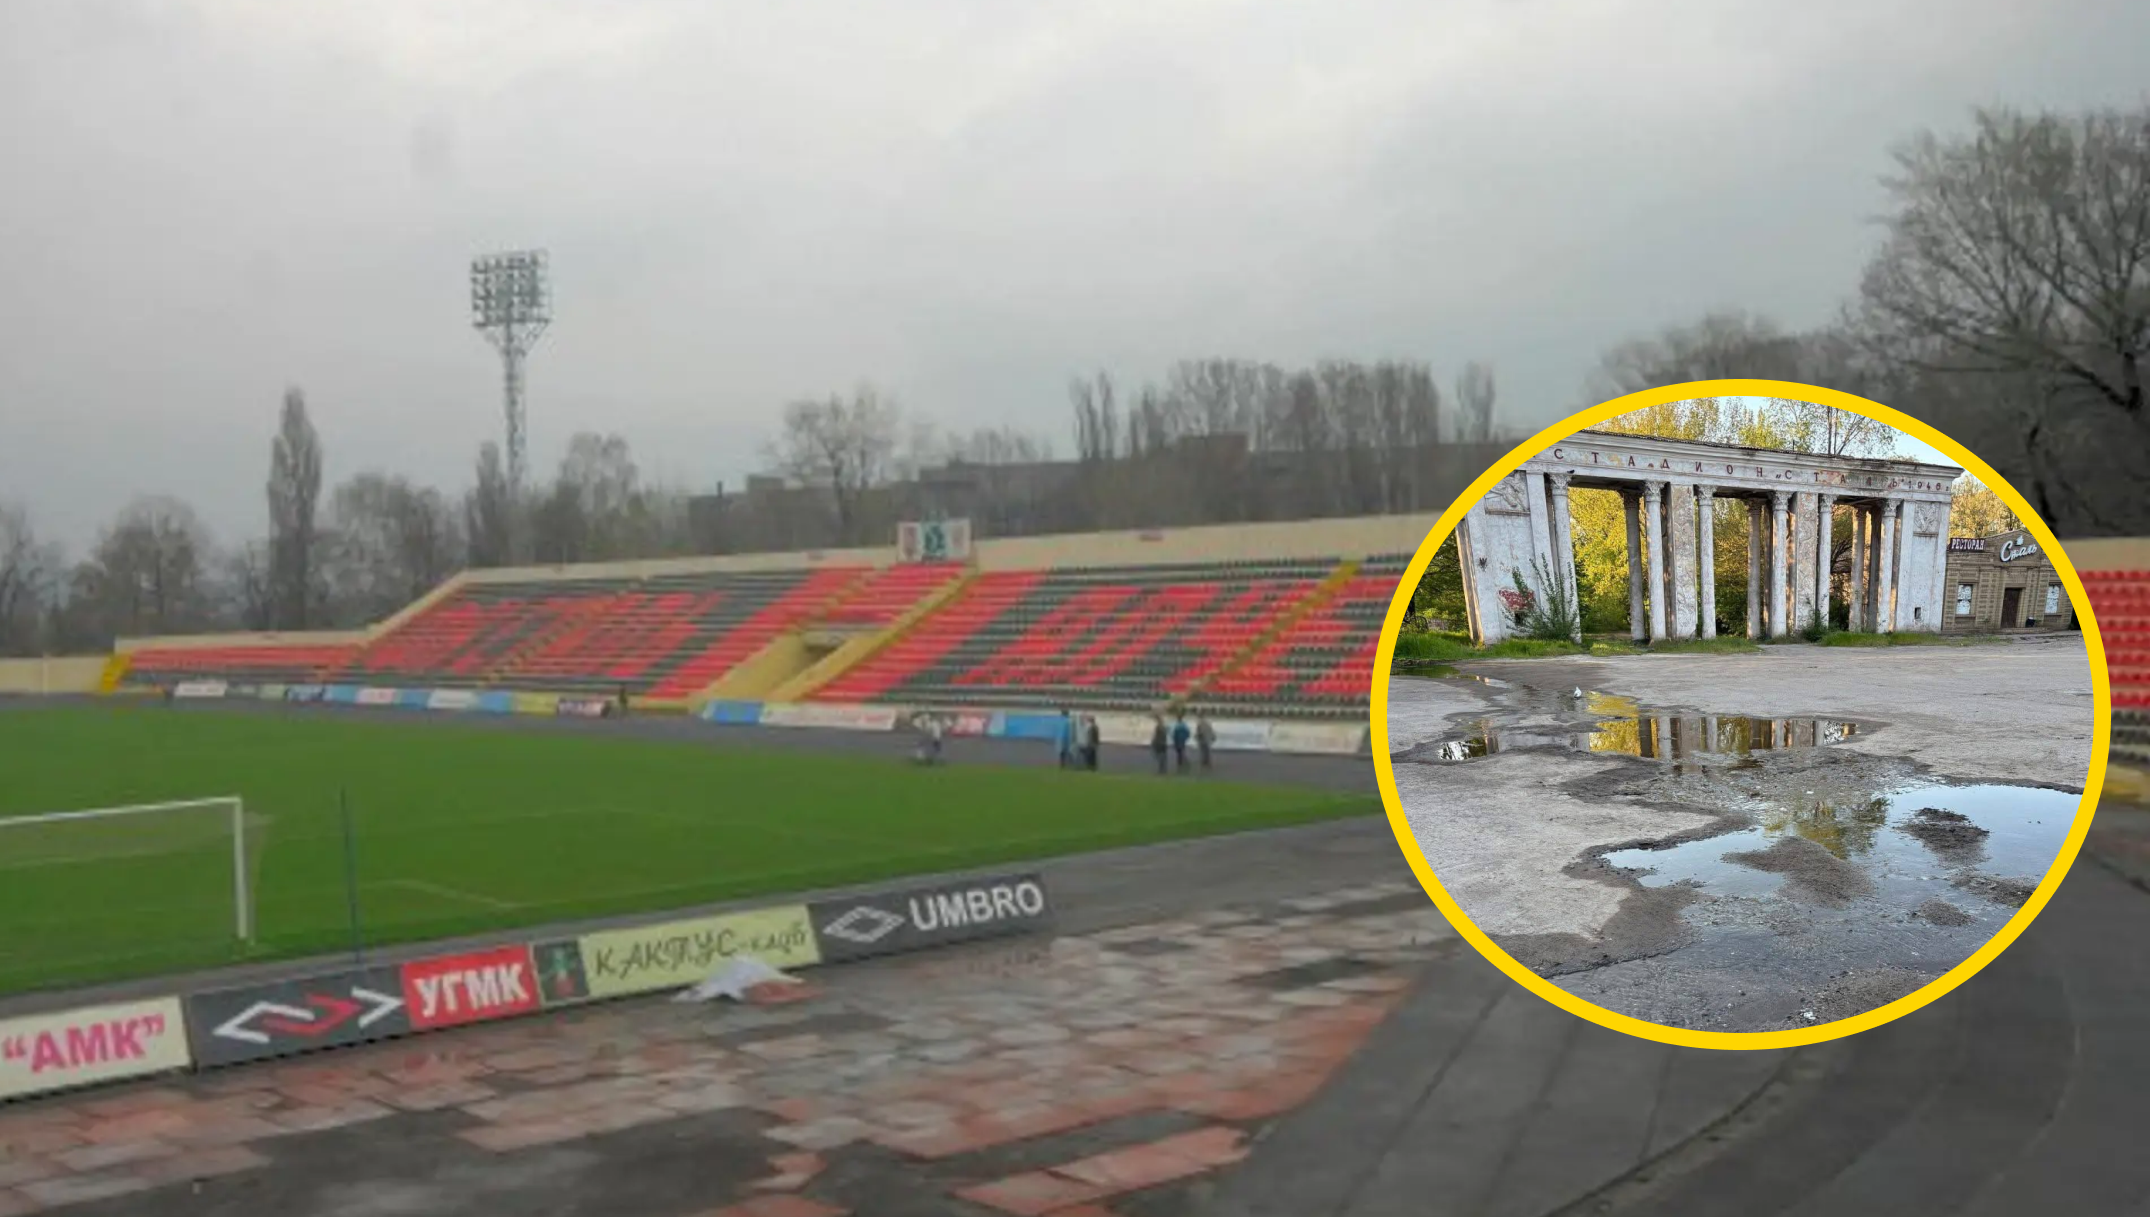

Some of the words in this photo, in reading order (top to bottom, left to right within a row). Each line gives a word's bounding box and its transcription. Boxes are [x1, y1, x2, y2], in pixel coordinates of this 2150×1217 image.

[1553, 448, 1765, 478] СТАДИОН
[1951, 538, 1985, 551] РЕСТОРАН
[2000, 540, 2038, 562] Сталь
[909, 881, 1045, 932] UMBRO
[415, 961, 527, 1018] УГМК
